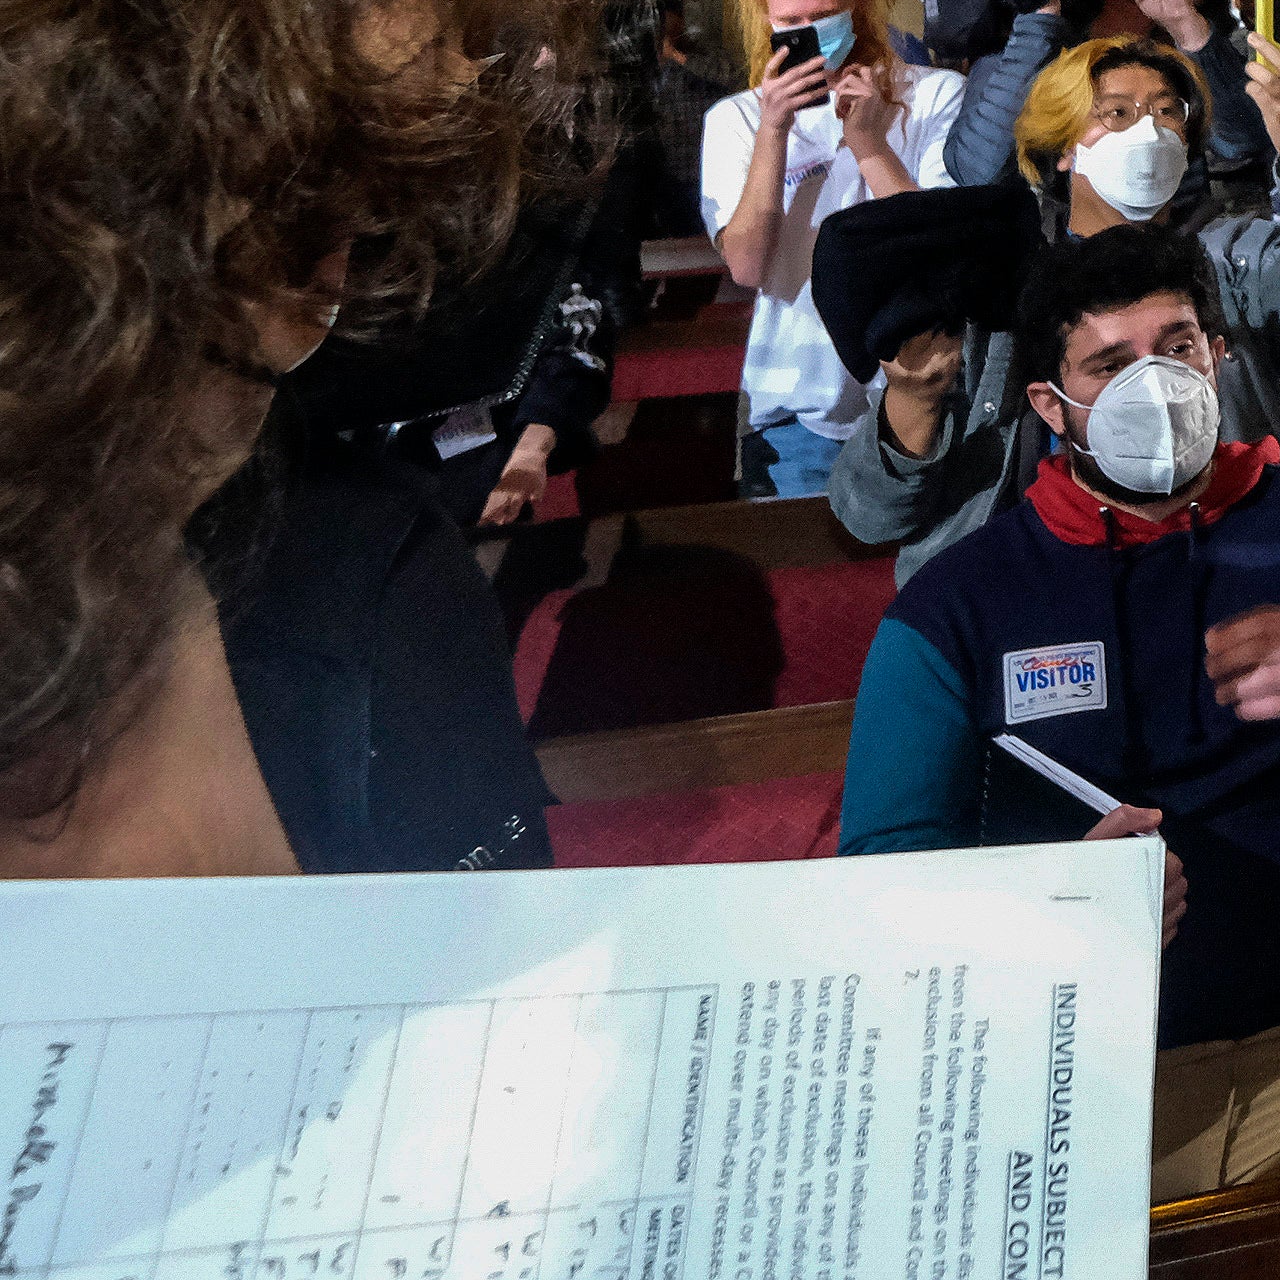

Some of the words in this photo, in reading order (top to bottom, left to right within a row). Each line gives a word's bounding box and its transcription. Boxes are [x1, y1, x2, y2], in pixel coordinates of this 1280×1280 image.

[1016, 663, 1096, 693] VISITOR
[817, 975, 836, 1008] last
[924, 967, 942, 1050] exclusion
[953, 964, 969, 1008] from
[692, 995, 712, 1041] NAME
[735, 982, 756, 1045] extend
[788, 978, 808, 1046] periods
[812, 1012, 832, 1053] date
[836, 973, 861, 1075] Committee
[950, 1012, 966, 1041] the
[973, 1017, 989, 1051] The
[731, 1050, 748, 1091] over
[858, 1045, 876, 1077] any
[920, 1054, 939, 1099] from
[1049, 983, 1078, 1154] INDIVIDUALS
[859, 1083, 877, 1102] of
[939, 1047, 964, 1131] following
[964, 1056, 988, 1140] following
[824, 1080, 847, 1167] meetings
[854, 1108, 874, 1158] these
[913, 1131, 932, 1201] Council
[934, 1136, 954, 1224] meetings
[1010, 1150, 1034, 1211] AND
[909, 1207, 924, 1241] and
[1044, 1162, 1070, 1280] SUBJECT
